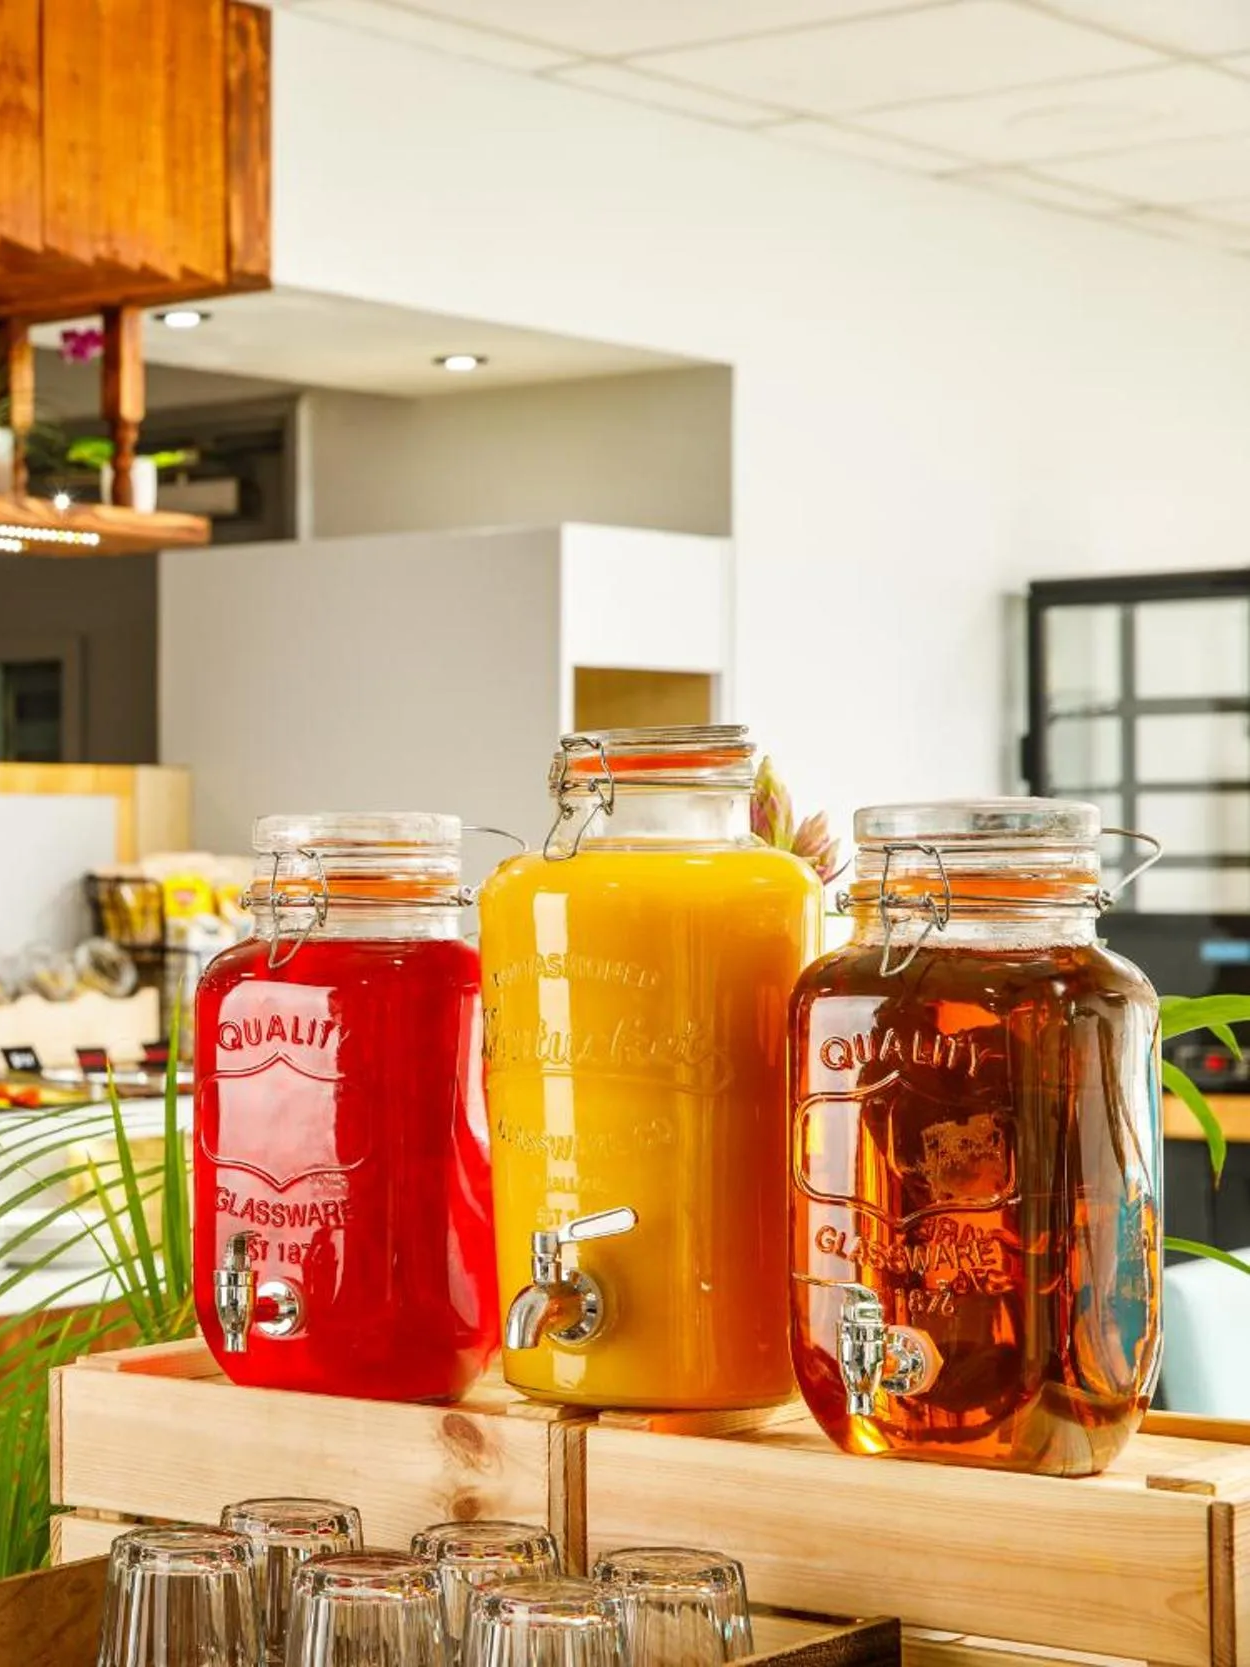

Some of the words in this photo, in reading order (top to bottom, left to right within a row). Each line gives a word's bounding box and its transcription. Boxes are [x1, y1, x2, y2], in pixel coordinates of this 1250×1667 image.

[819, 1027, 977, 1078] QUALITY
[215, 1186, 354, 1228] GLASSWARE
[814, 1224, 999, 1276] GLASSWARE
